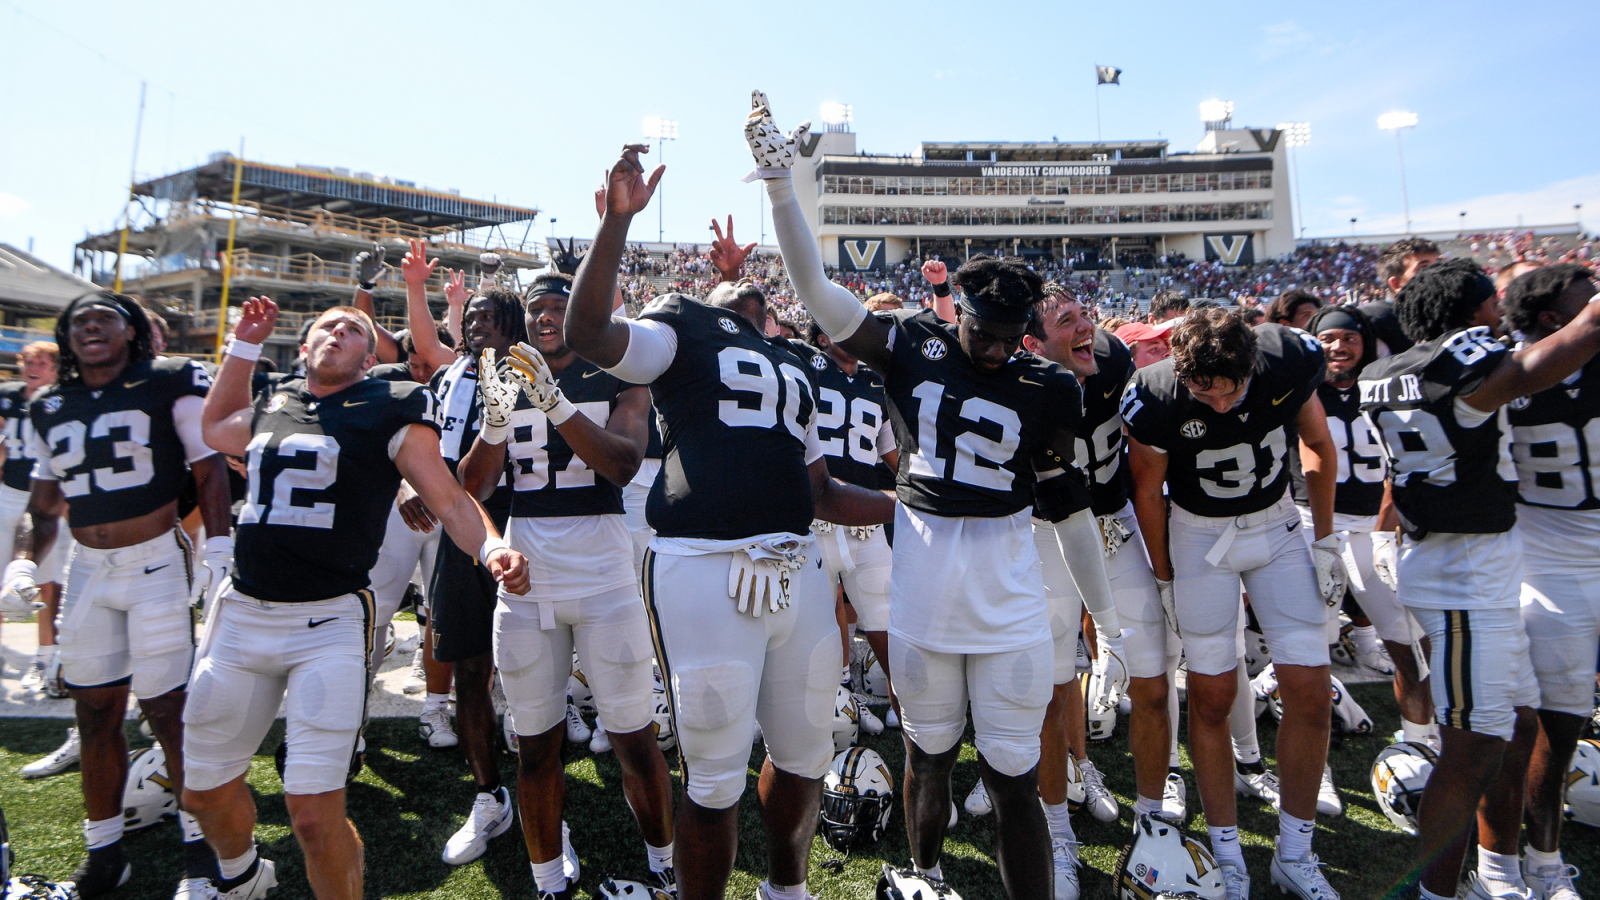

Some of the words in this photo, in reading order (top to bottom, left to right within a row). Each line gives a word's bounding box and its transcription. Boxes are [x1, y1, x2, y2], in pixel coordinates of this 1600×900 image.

[981, 166, 1040, 177] VANDERBILT
[1042, 165, 1112, 176] COMMODORES
[719, 318, 738, 333] SEC
[924, 338, 946, 359] SEC
[811, 355, 826, 370] SEC
[1397, 373, 1422, 401] JR
[717, 346, 817, 444] 90
[816, 387, 883, 467] 28
[908, 380, 1022, 492] 12
[1182, 421, 1205, 438] SEC
[47, 409, 155, 498] 23
[1196, 425, 1288, 499] 31
[237, 431, 341, 529] 12
